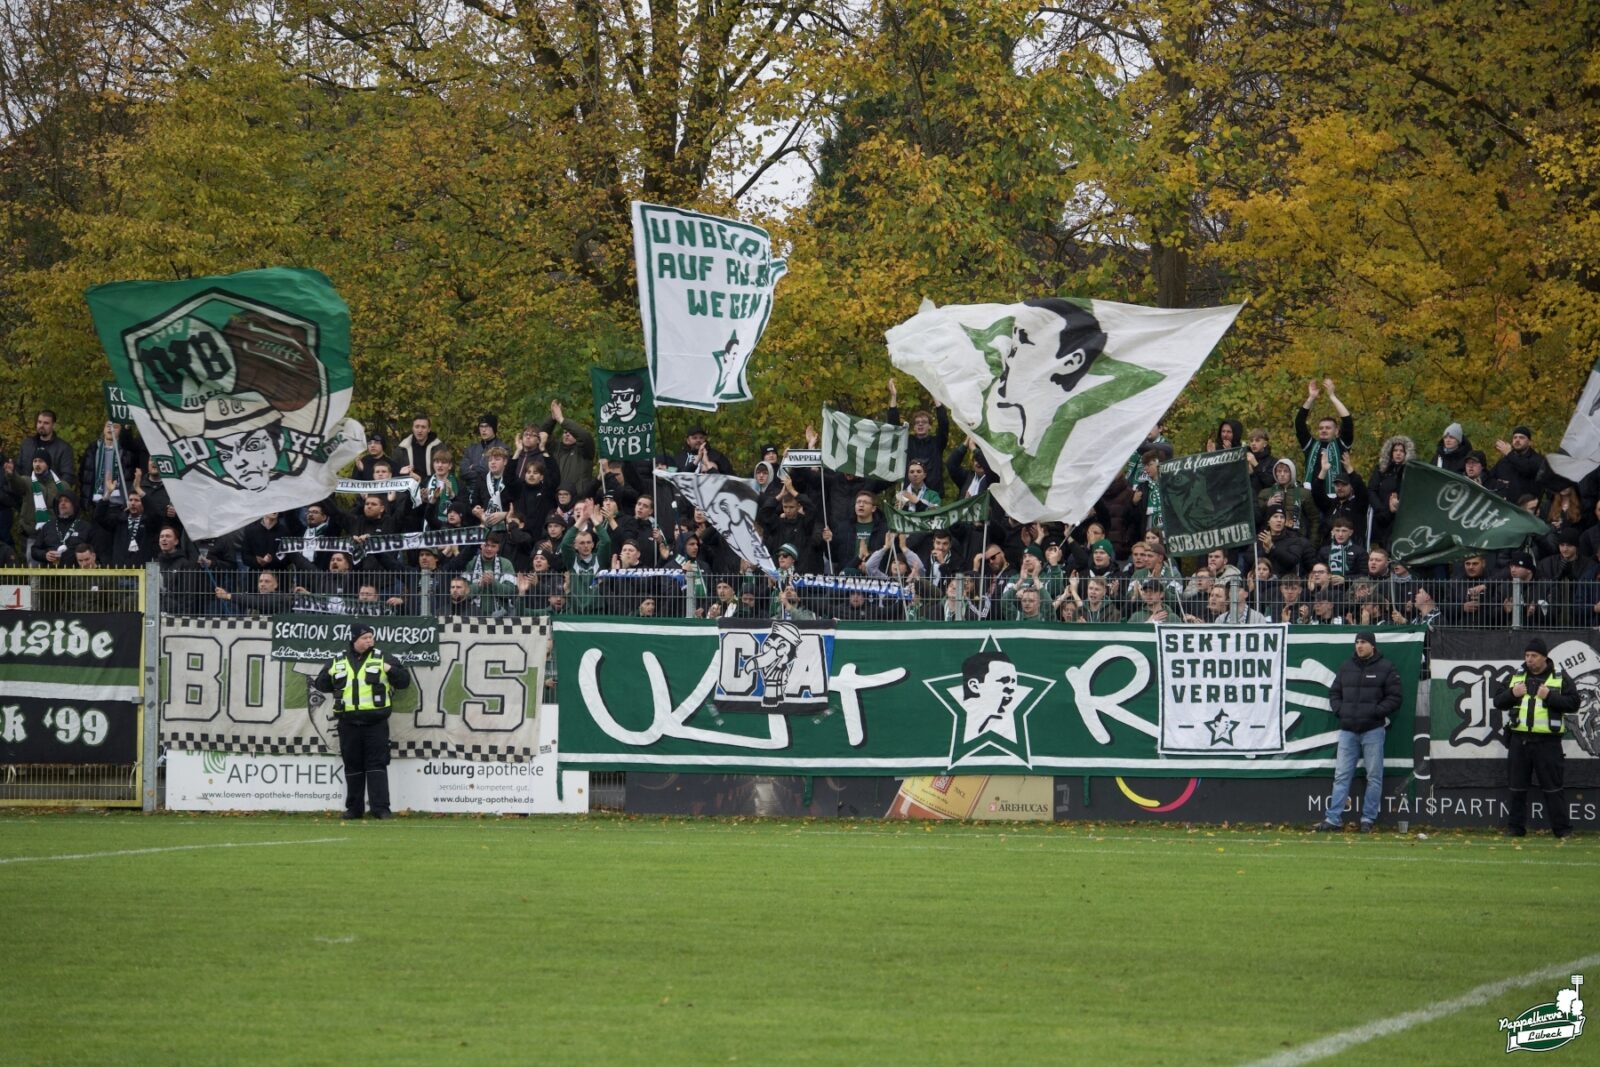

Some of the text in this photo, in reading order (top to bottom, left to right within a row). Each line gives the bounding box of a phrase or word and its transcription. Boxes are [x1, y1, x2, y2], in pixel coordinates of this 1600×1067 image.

[658, 253, 713, 281] AUF
[598, 422, 654, 435] SUPER EASY
[1183, 456, 1193, 470] &
[1168, 523, 1250, 554] SUBKULTUR
[803, 573, 900, 595] CASTAWAYS
[5, 587, 24, 609] 1
[275, 621, 329, 641] SEKTION
[1165, 632, 1279, 653] SEKTION
[1171, 658, 1273, 679] STADION
[1558, 651, 1587, 670] 1919
[1171, 684, 1273, 704] VERBOT
[226, 763, 344, 785] APOTHEK
[201, 791, 342, 801] www.loewen-apotheke-flensburg.de
[433, 796, 534, 805] www.duburg-apotheke.de
[998, 803, 1049, 813] AREHUCAS
